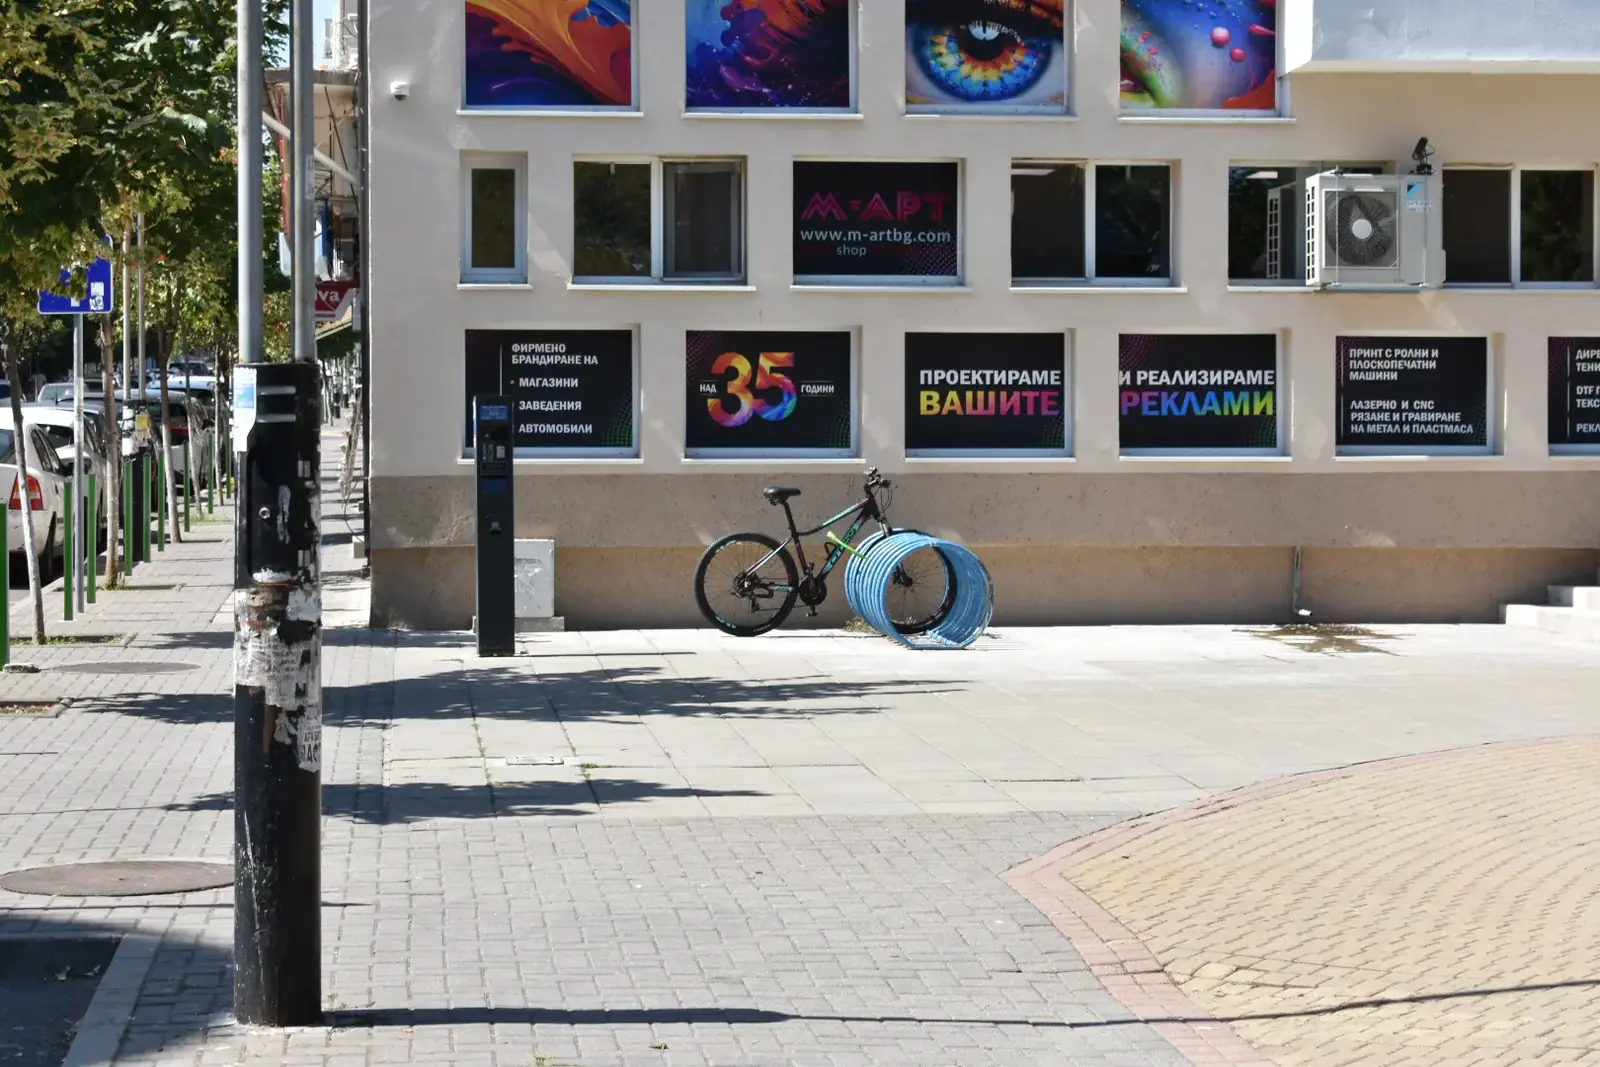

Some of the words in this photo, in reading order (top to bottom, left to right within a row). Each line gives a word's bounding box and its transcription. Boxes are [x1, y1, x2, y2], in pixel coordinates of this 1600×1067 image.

[800, 228, 950, 244] www.m-artbg.com
[836, 244, 867, 257] shop
[511, 343, 567, 353] ФИРМЕНО
[1349, 348, 1384, 359] ПРИНТ
[1394, 348, 1429, 359] РОЛНИ
[1431, 348, 1439, 359] И
[511, 354, 582, 366] БРАНДИРАНЕ
[583, 355, 599, 365] НА
[1349, 359, 1437, 370] ПЛОСКОПЕЧАТНИ
[920, 370, 1061, 385] ПРОЕКТИРАМЕ
[1119, 371, 1130, 385] И
[1137, 370, 1274, 385] РЕАЛИЗИРАМЕ
[1349, 370, 1398, 381] МАШИНИ
[519, 377, 579, 388] МАГАЗИНИ
[699, 384, 718, 394] НАД
[707, 352, 797, 427] 35
[800, 384, 835, 395] ГОДИНИ
[1576, 385, 1595, 395] DTF
[518, 400, 582, 412] ЗАВЕДЕНИЯ
[920, 391, 1061, 415] ВАШИТЕ
[1122, 391, 1273, 416] РЕКЛАМИ
[1350, 399, 1398, 410] ЛАЗЕРНО
[1401, 399, 1409, 410] И
[1413, 399, 1435, 410] CNC
[1350, 411, 1391, 422] РЯЗАНЕ
[1392, 411, 1400, 422] И
[1401, 411, 1462, 422] ГРАВИРАНЕ
[518, 423, 593, 434] АВТОМОБИЛИ
[1350, 423, 1365, 434] НА
[1366, 423, 1401, 434] МЕТАЛ
[1402, 423, 1411, 434] И
[1412, 423, 1474, 434] ПЛАСТМАСА
